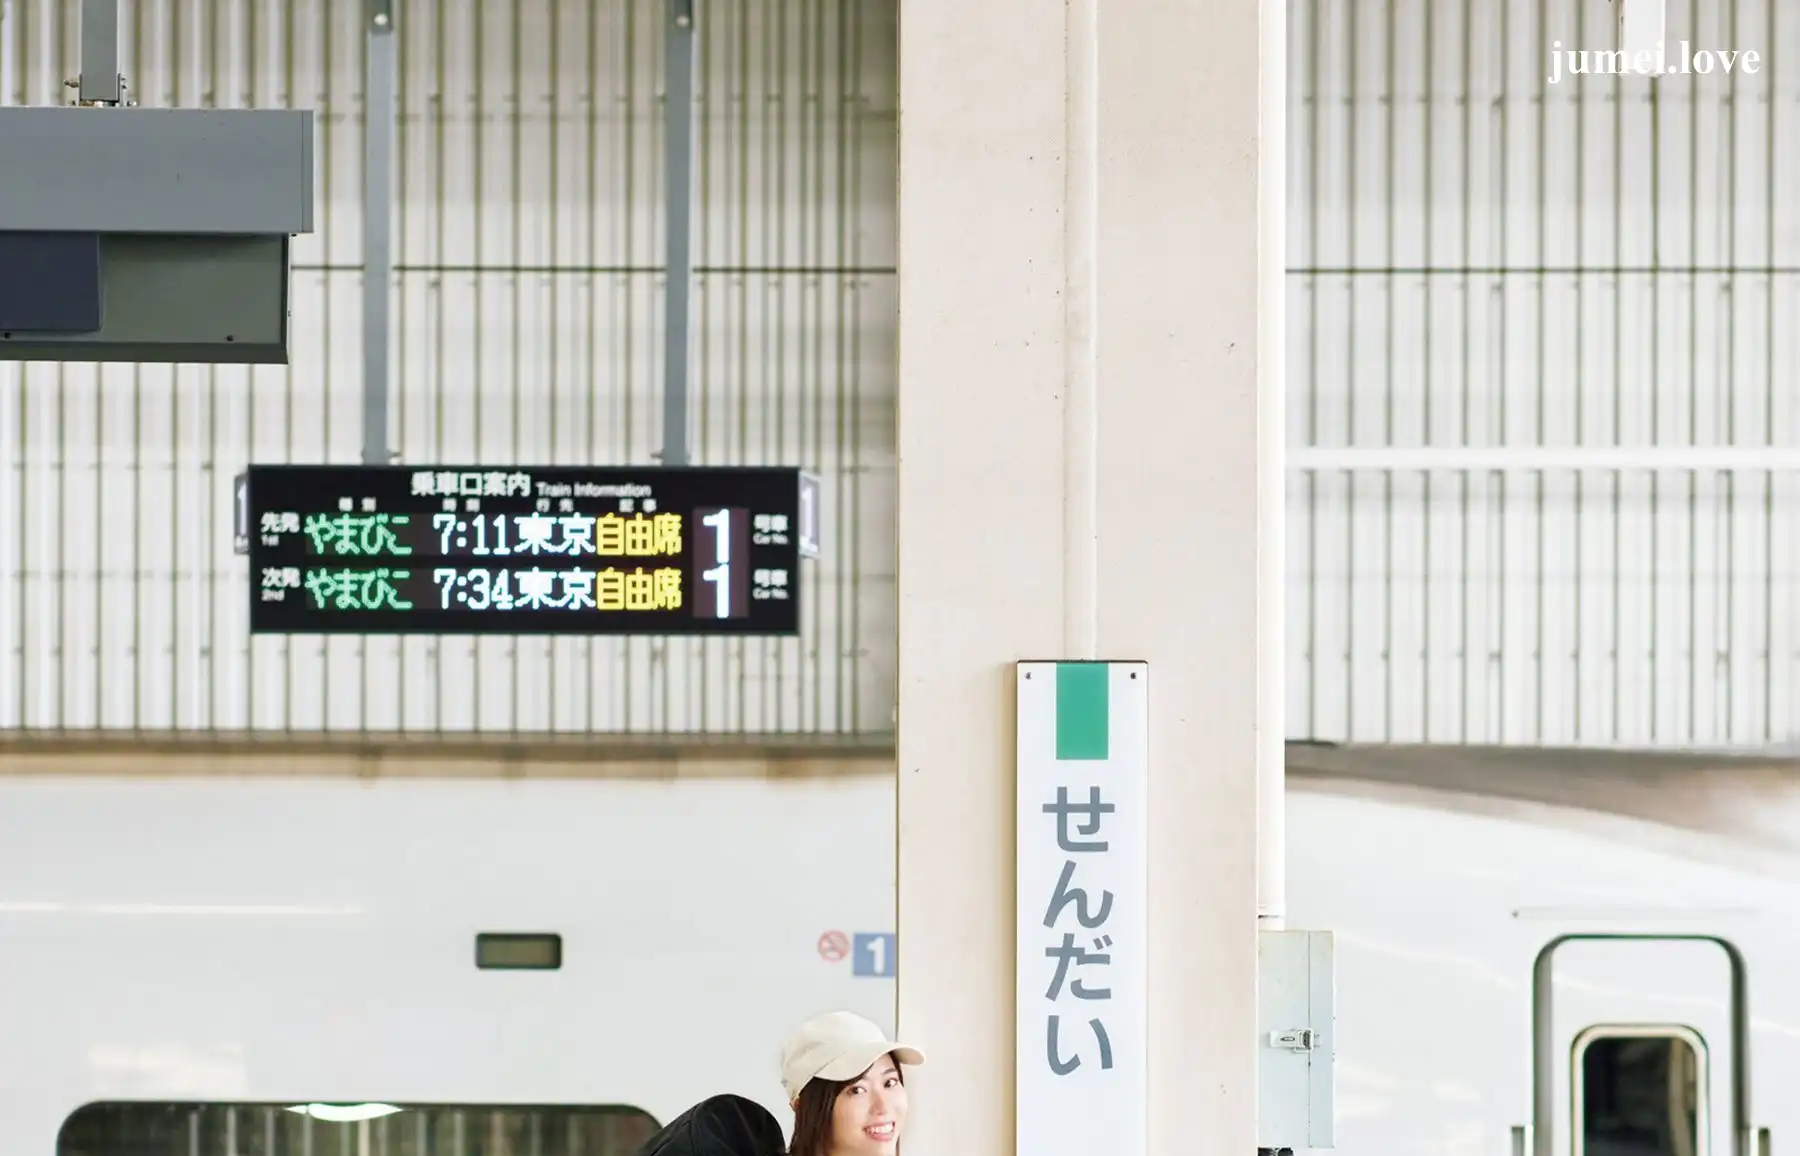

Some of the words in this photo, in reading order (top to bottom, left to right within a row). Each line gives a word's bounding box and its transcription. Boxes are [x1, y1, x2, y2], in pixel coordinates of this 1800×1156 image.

[535, 482, 572, 497] Train
[573, 482, 652, 497] Information
[304, 513, 413, 555] やまびこ
[433, 513, 511, 555] 7:11
[512, 512, 596, 555] 東京
[596, 512, 682, 556] 自由席
[702, 508, 730, 564] 1
[305, 568, 413, 610] やまびこ
[433, 568, 513, 610] 7:34
[512, 567, 596, 610] 東京
[596, 567, 682, 610] 自由席
[702, 563, 730, 619] 1
[1042, 786, 1116, 1077] せんだい
[866, 936, 885, 974] 1
